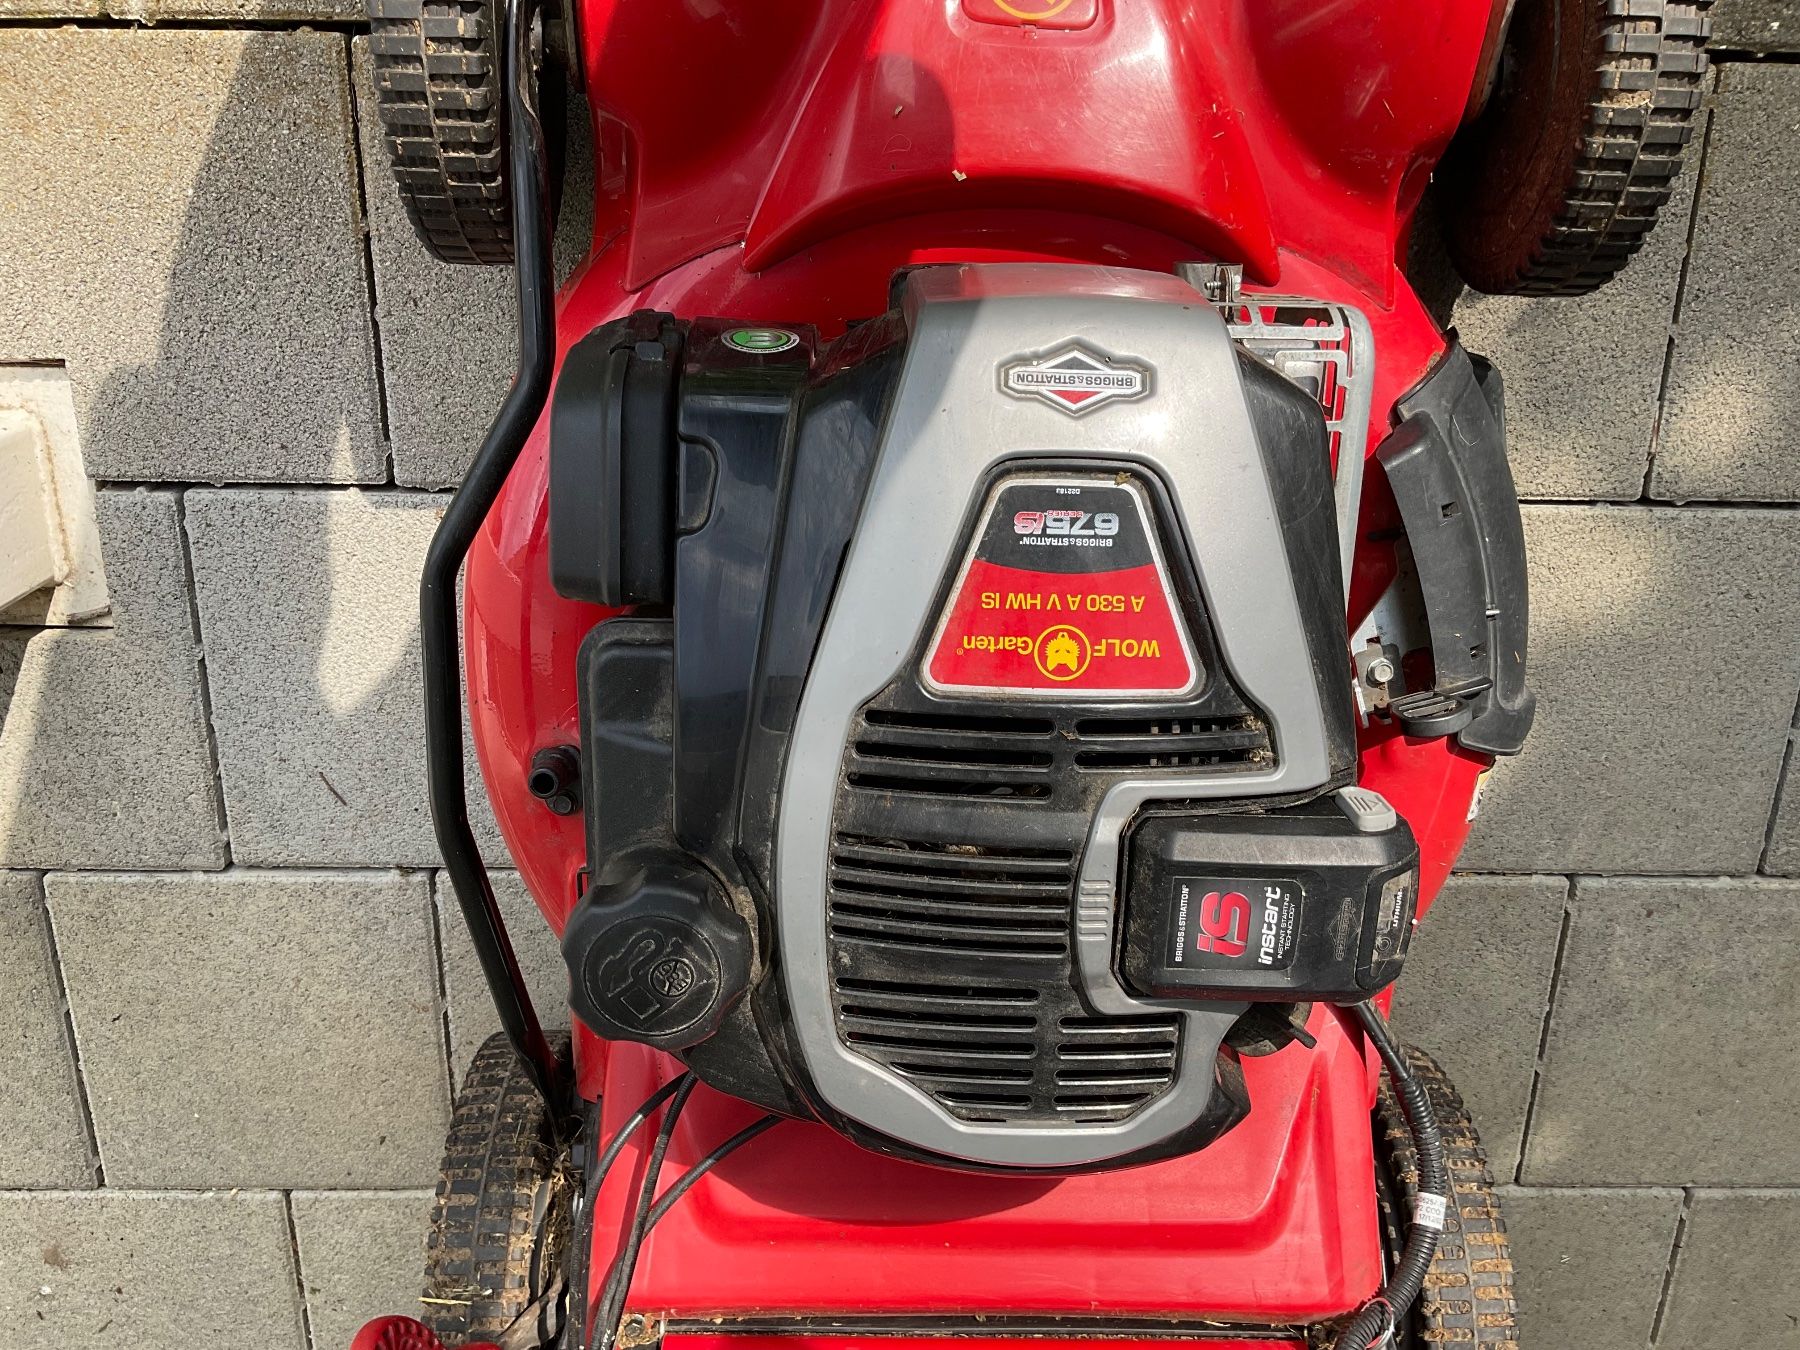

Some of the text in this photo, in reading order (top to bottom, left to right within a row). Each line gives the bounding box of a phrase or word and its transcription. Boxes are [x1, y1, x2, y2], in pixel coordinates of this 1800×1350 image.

[981, 592, 1145, 612] A 530 A V HW IS
[1093, 639, 1160, 657] WOLF
[1258, 886, 1280, 964] instart
[1277, 894, 1290, 959] INSTANT STARTING
[1285, 903, 1295, 950] TECHNOLOGY
[1393, 888, 1403, 928] LITHIUM
